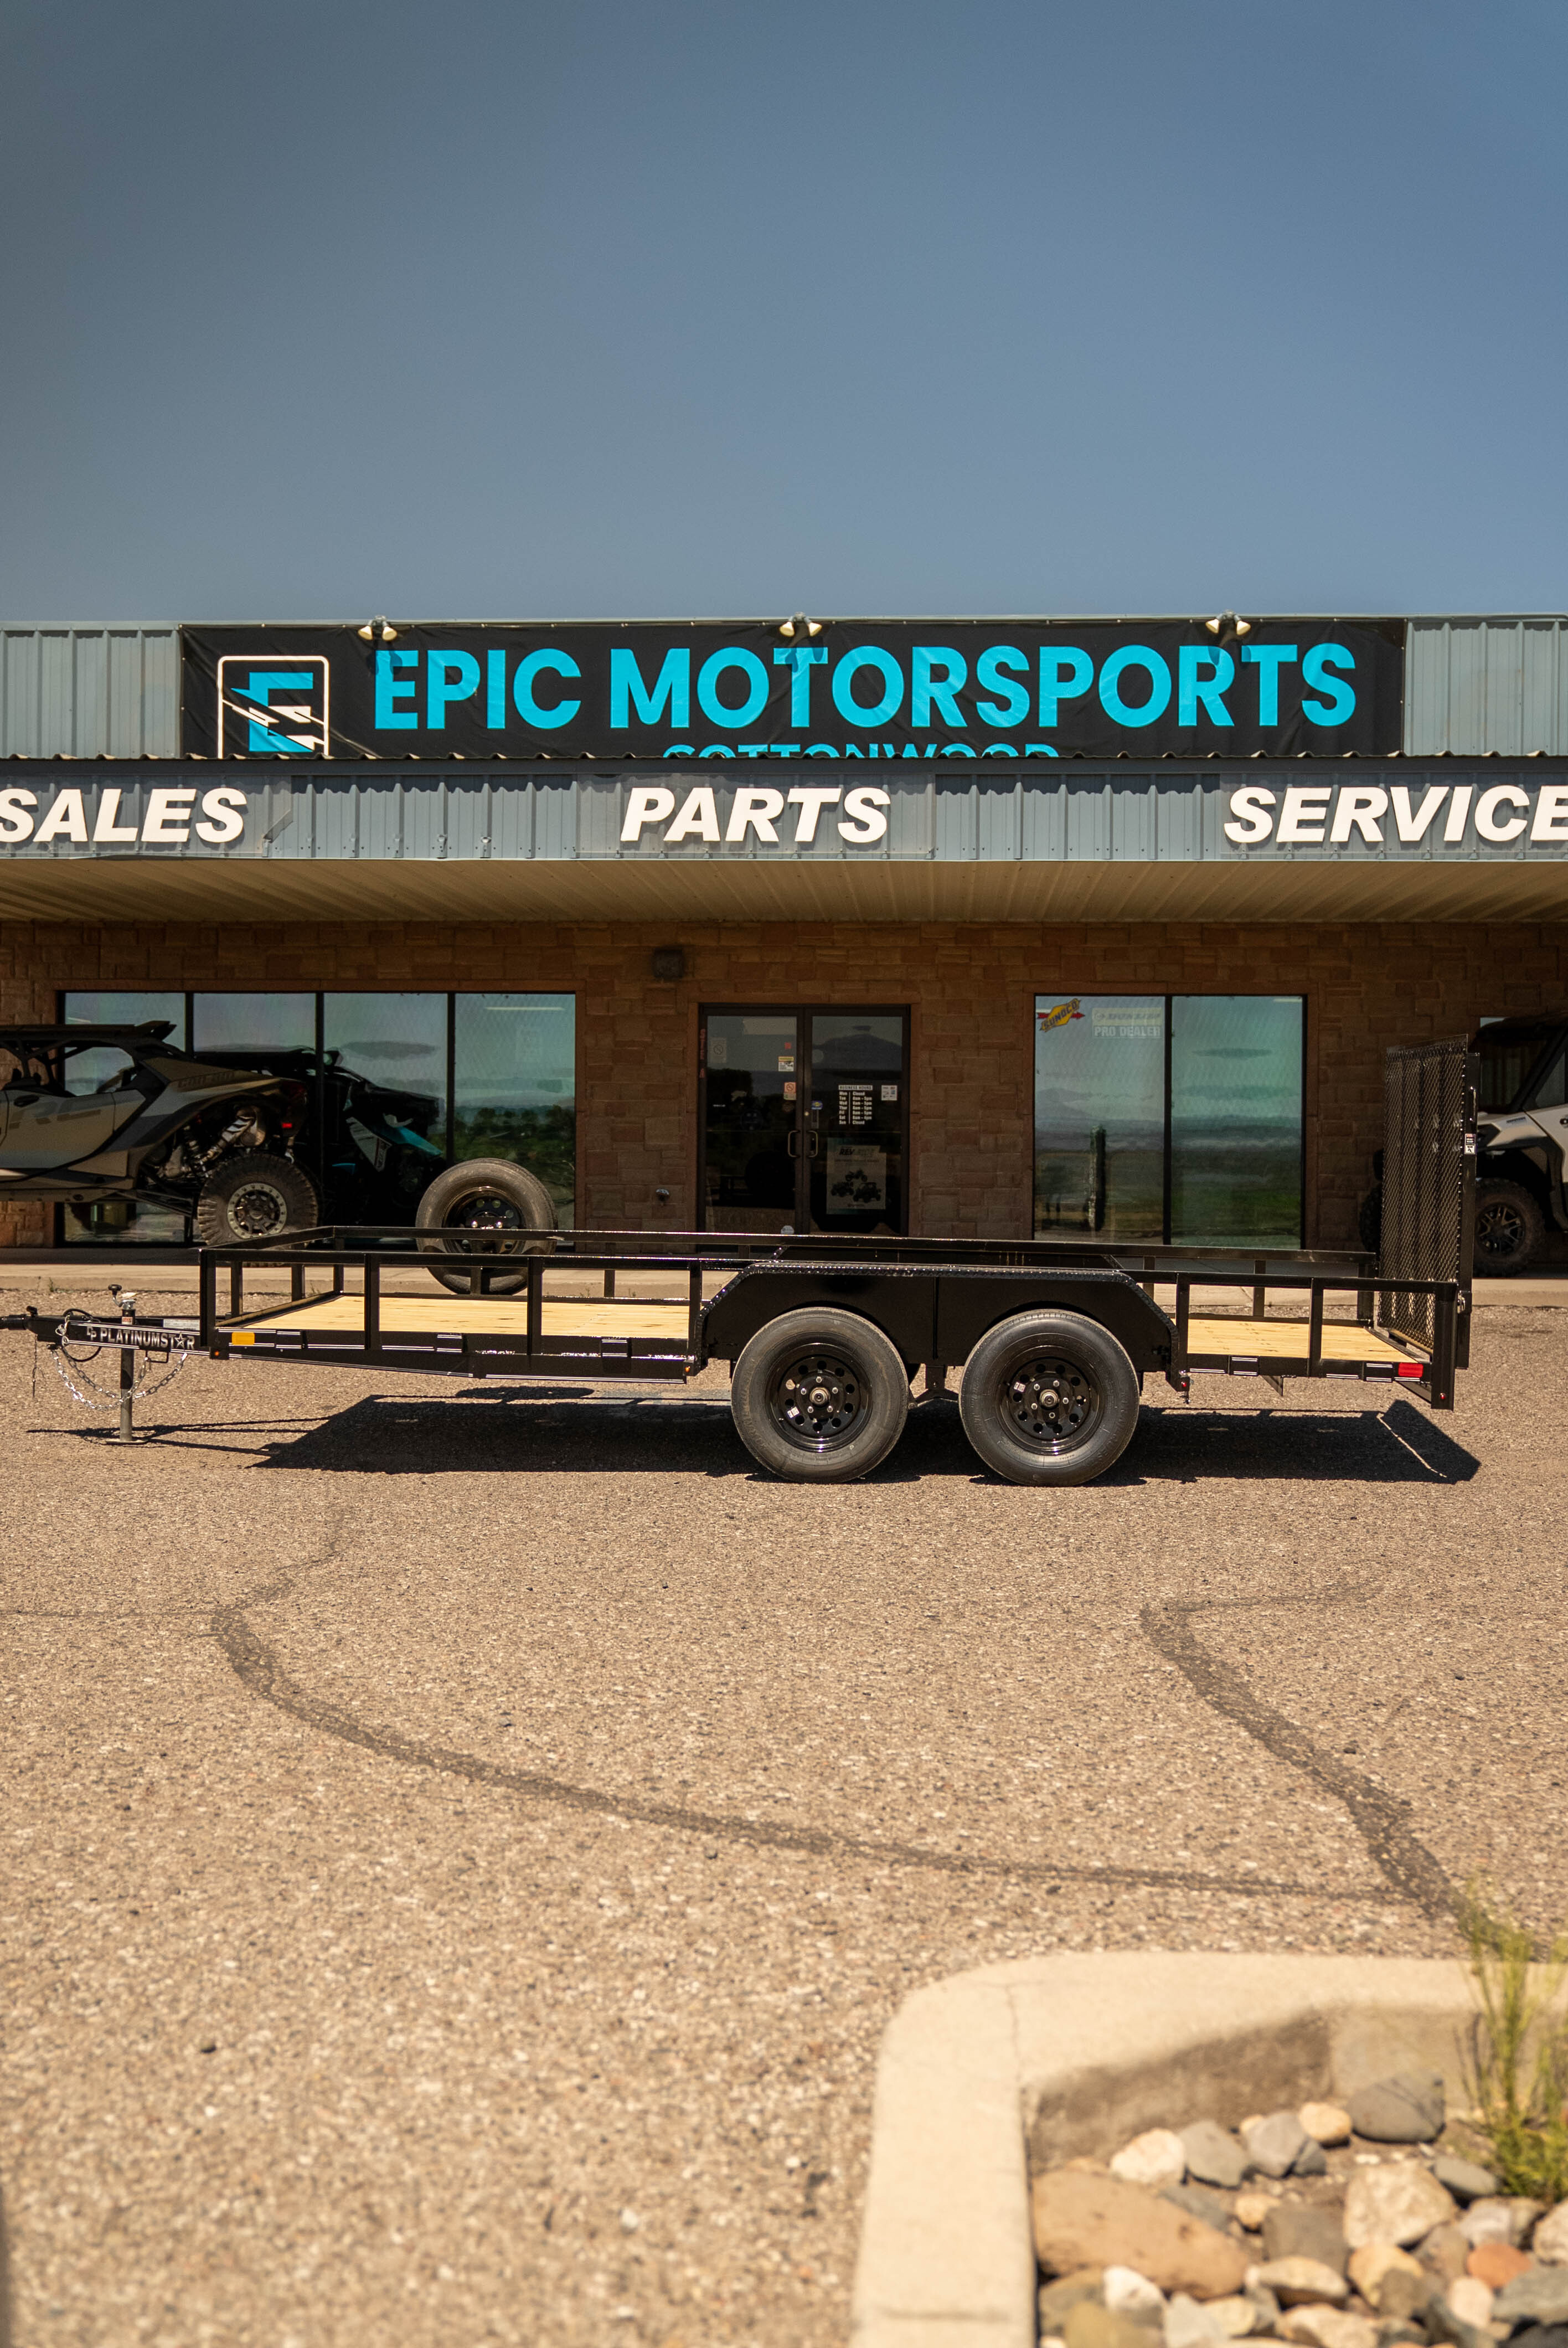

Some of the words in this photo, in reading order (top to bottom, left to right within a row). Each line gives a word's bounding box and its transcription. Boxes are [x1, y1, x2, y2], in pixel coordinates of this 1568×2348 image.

[374, 648, 581, 730] EPIC
[610, 642, 1356, 729] MOTORSPORTS
[0, 788, 247, 843] SALES
[620, 787, 891, 843] PARTS
[1224, 786, 1568, 843] SERVICE
[1043, 1000, 1078, 1029] SUNOCO
[1094, 1026, 1116, 1037] PRO
[1119, 1026, 1161, 1037] DEALER
